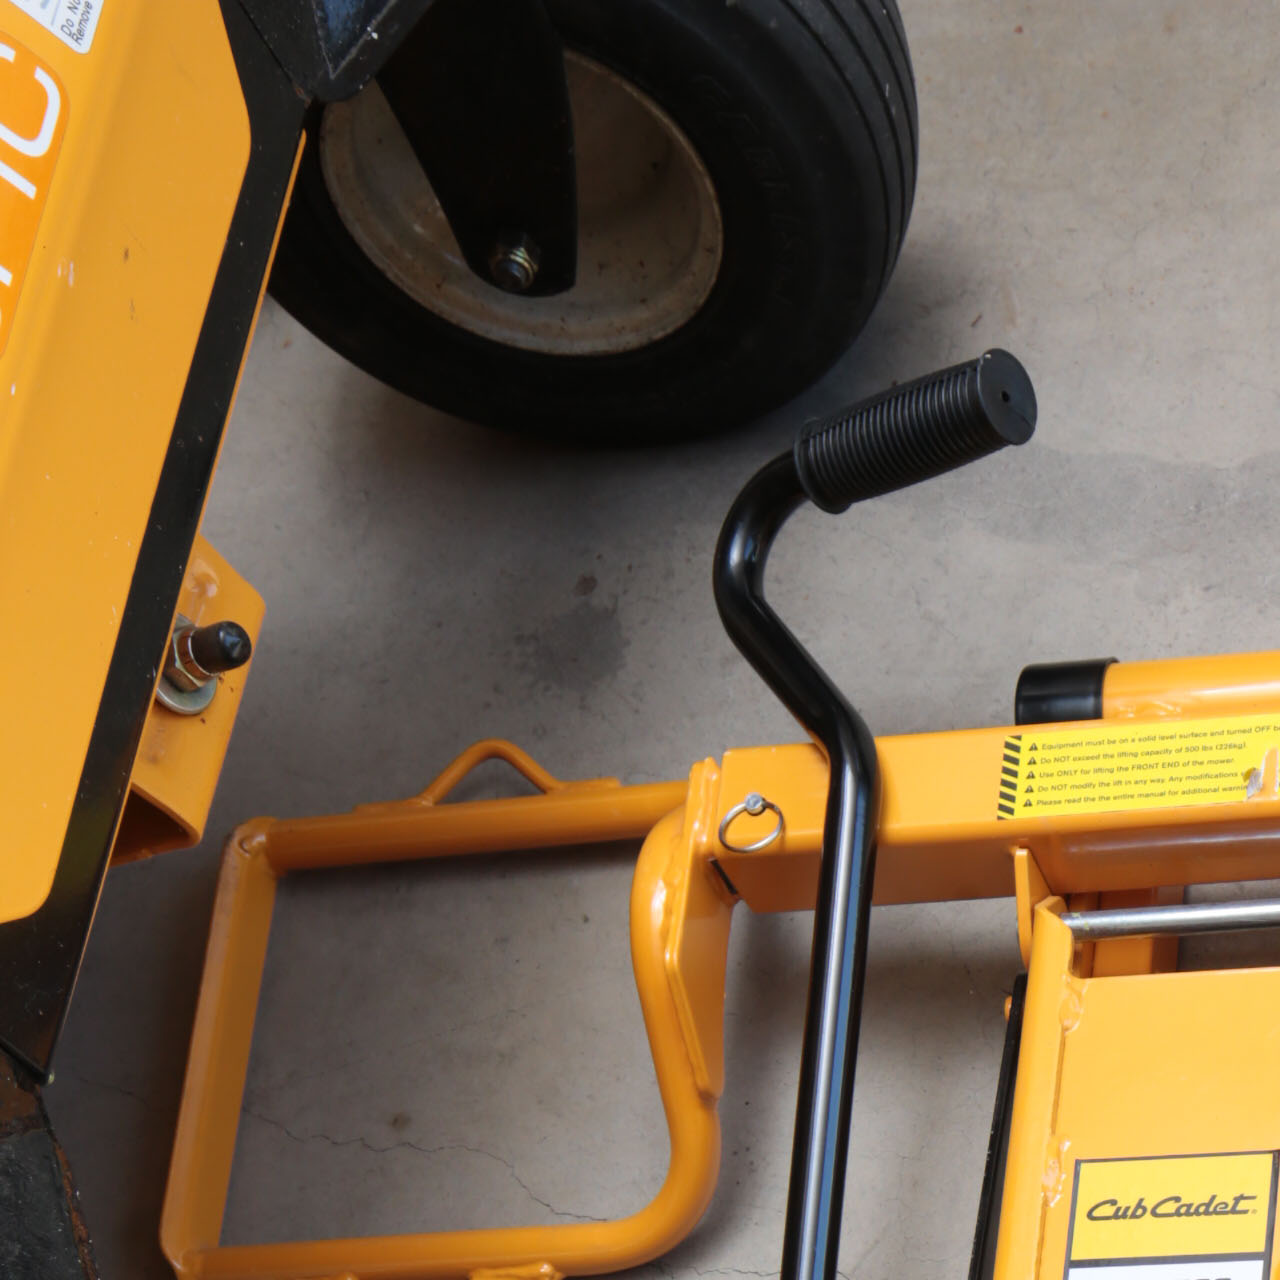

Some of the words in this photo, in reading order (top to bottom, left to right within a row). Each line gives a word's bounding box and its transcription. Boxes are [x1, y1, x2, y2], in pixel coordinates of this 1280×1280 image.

[60, 18, 74, 36] Do
[72, 1, 92, 46] Remove
[1042, 742, 1082, 750] Equipment
[1141, 748, 1172, 756] capacity
[1186, 772, 1238, 780] modifications
[1182, 787, 1219, 795] additional
[1086, 1198, 1147, 1221] Cub
[1150, 1194, 1257, 1218] Cadet
